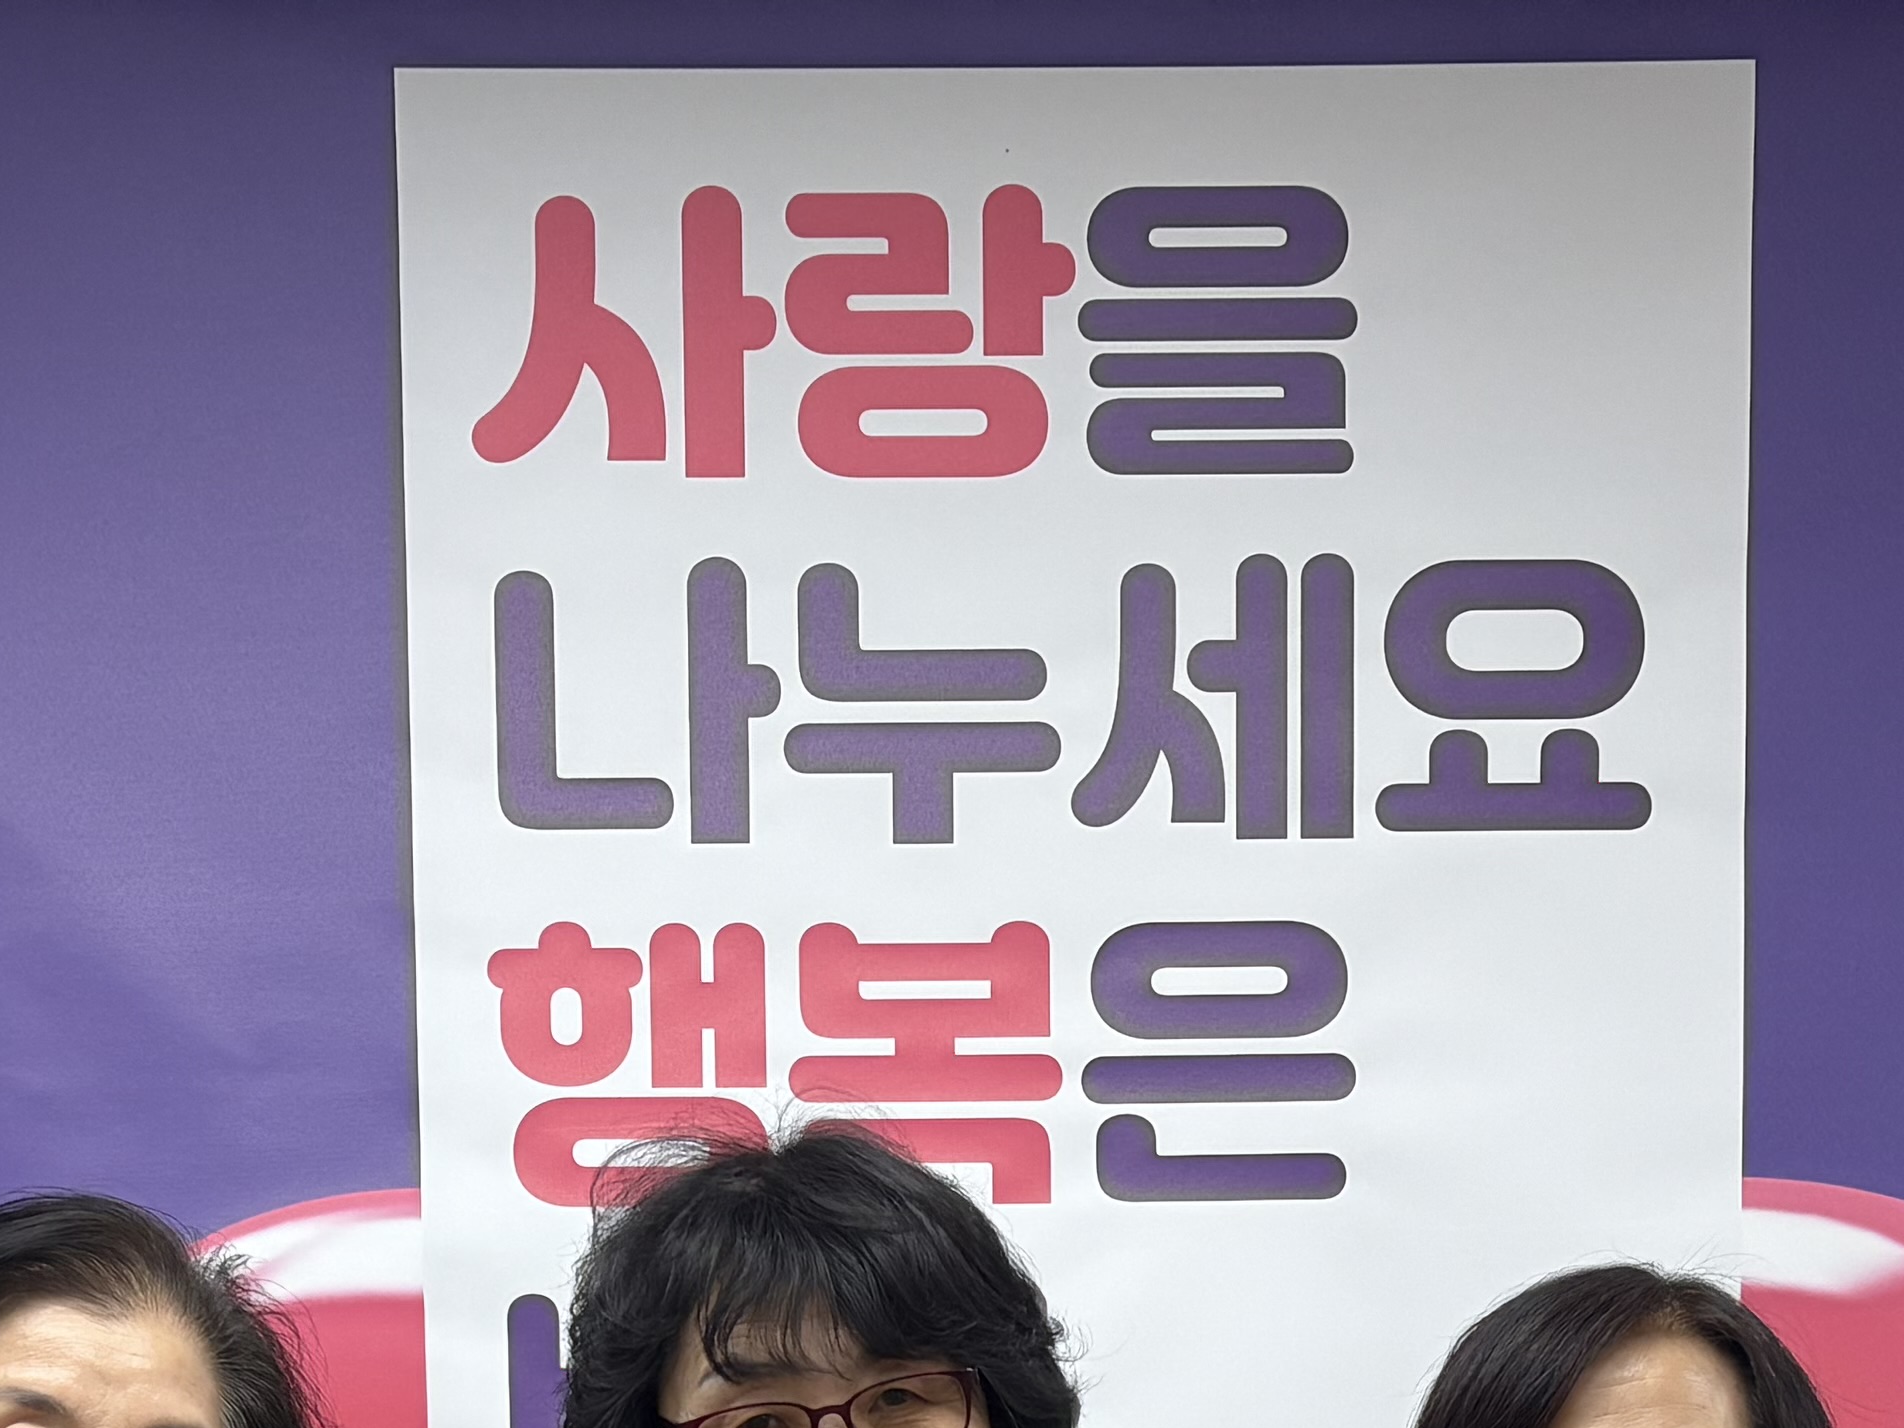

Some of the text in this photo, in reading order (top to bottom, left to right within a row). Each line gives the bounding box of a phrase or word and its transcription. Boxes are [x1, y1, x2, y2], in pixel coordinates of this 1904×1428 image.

[470, 183, 1359, 479] 사랑을
[492, 551, 1654, 846] 나누세요
[485, 919, 1358, 1208] 행복은
